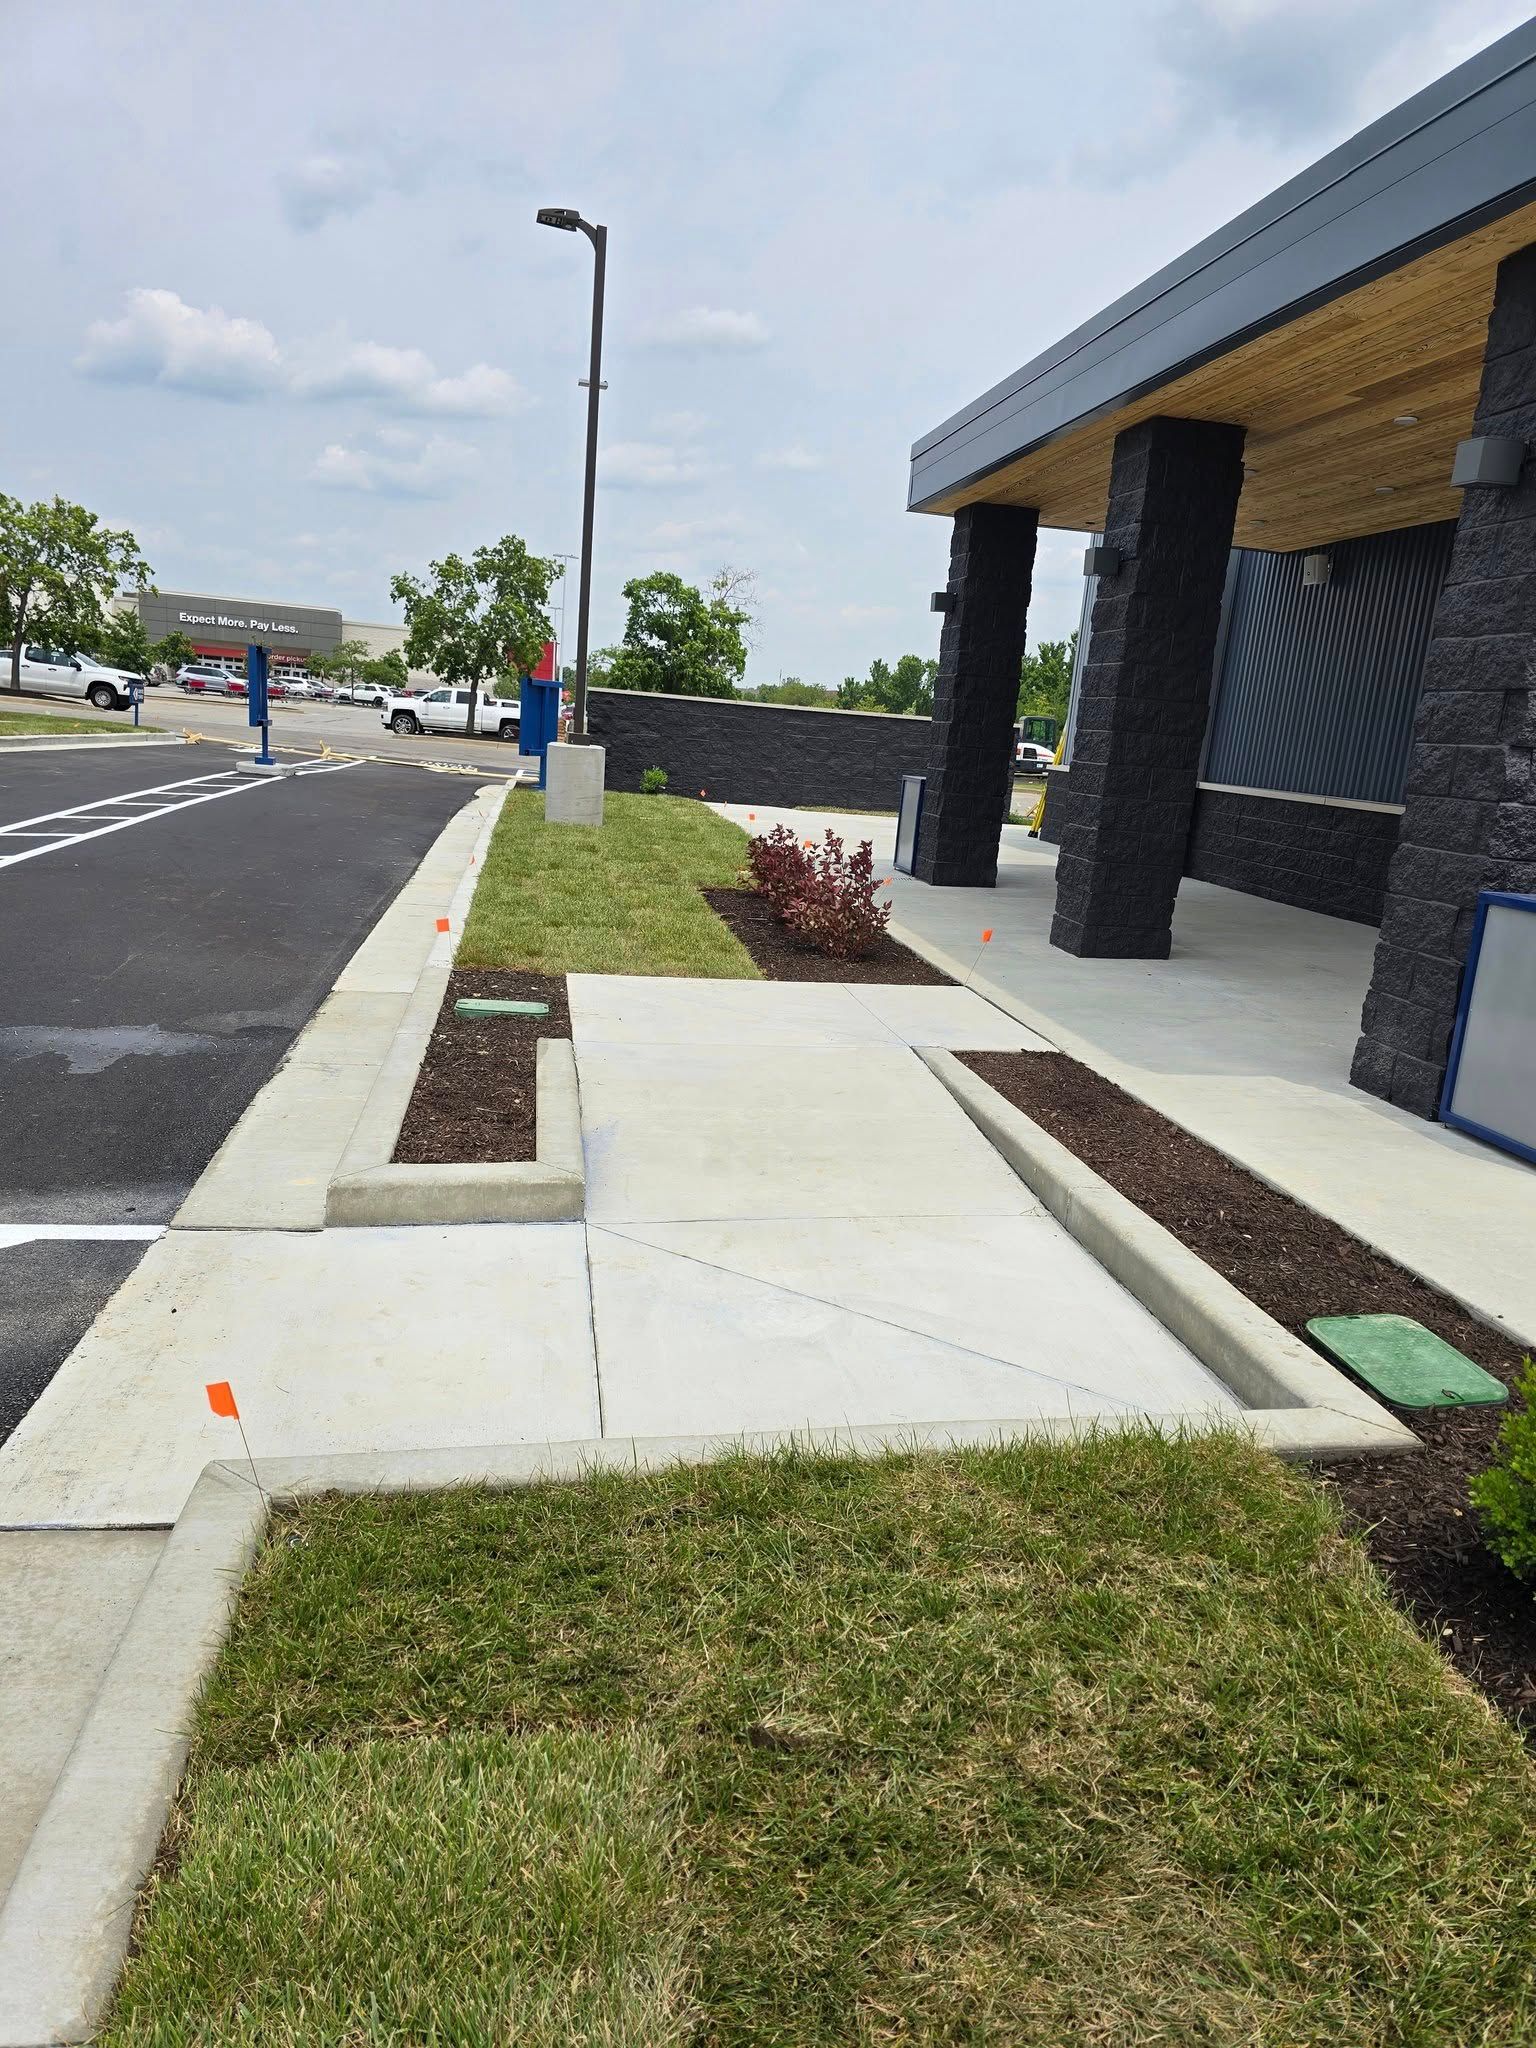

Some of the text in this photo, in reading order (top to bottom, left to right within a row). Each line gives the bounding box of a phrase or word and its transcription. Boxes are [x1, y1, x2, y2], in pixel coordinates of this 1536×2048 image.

[179, 612, 299, 634] Expect More. Pay Less.
